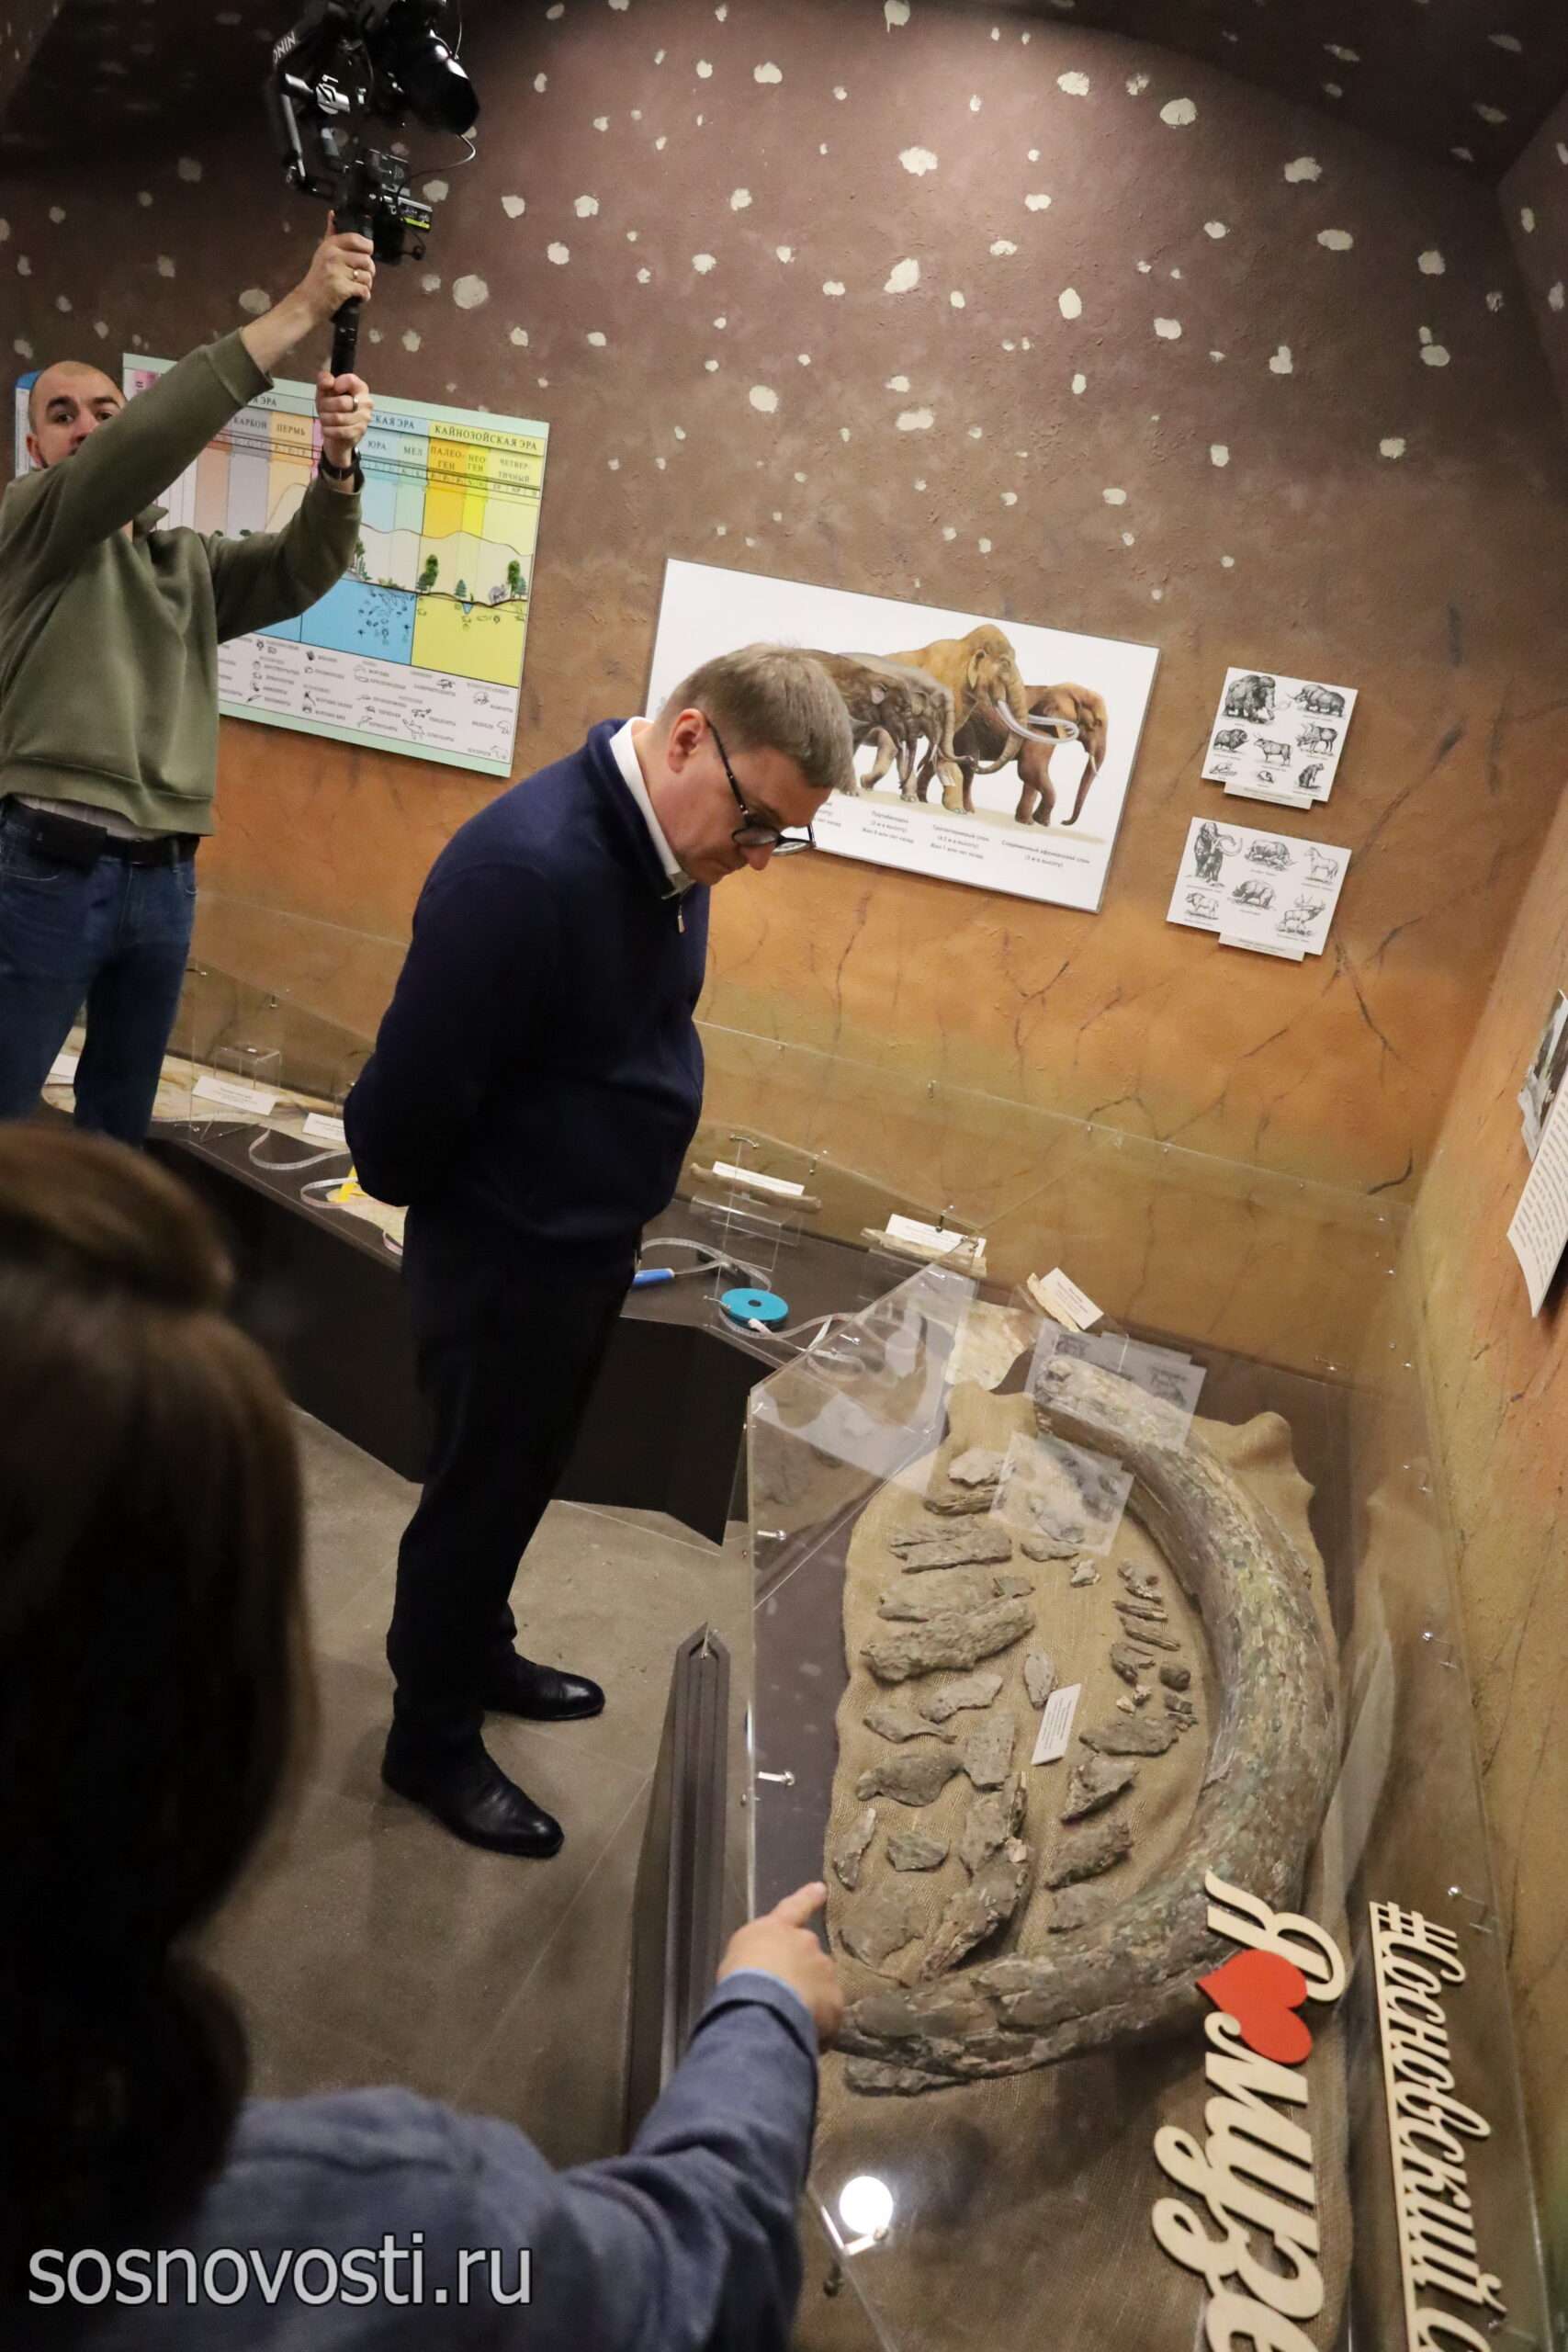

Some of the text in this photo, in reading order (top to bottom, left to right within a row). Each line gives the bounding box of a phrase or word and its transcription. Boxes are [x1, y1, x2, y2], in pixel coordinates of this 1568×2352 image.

[261, 398, 277, 406] ЭРА
[233, 416, 267, 429] КАРБОН
[397, 416, 415, 429] ЭРА
[276, 424, 306, 436] ПЕРМЬ
[434, 424, 537, 450] КАЙНОЗОЙСКАЯ ЭРА
[367, 440, 387, 450] ЮРА
[403, 446, 423, 456] МЕЛ
[437, 460, 455, 469] ГЕН
[468, 463, 484, 471] ГЕН
[1204, 1870, 1346, 2002] Я
[1369, 1900, 1508, 2314] #Сосновский
